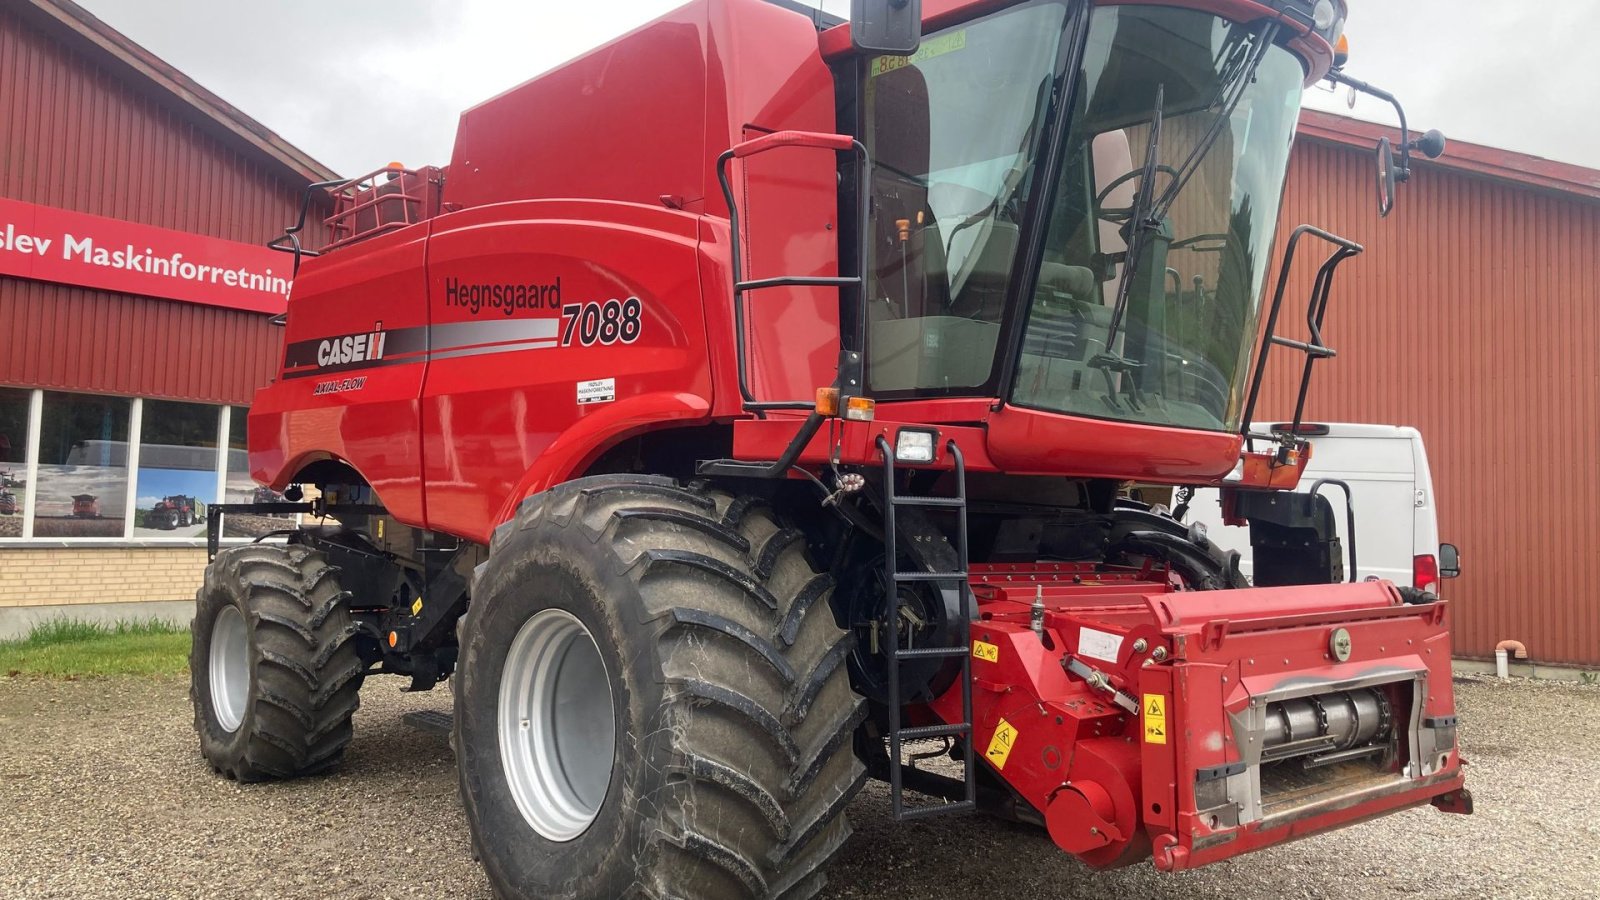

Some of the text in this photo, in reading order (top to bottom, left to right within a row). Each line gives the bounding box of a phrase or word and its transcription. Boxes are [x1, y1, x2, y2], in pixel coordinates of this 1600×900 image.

[446, 277, 561, 315] Hegnsgaard
[561, 296, 642, 347] 7088
[312, 375, 368, 396] AXIAL-FLOW
